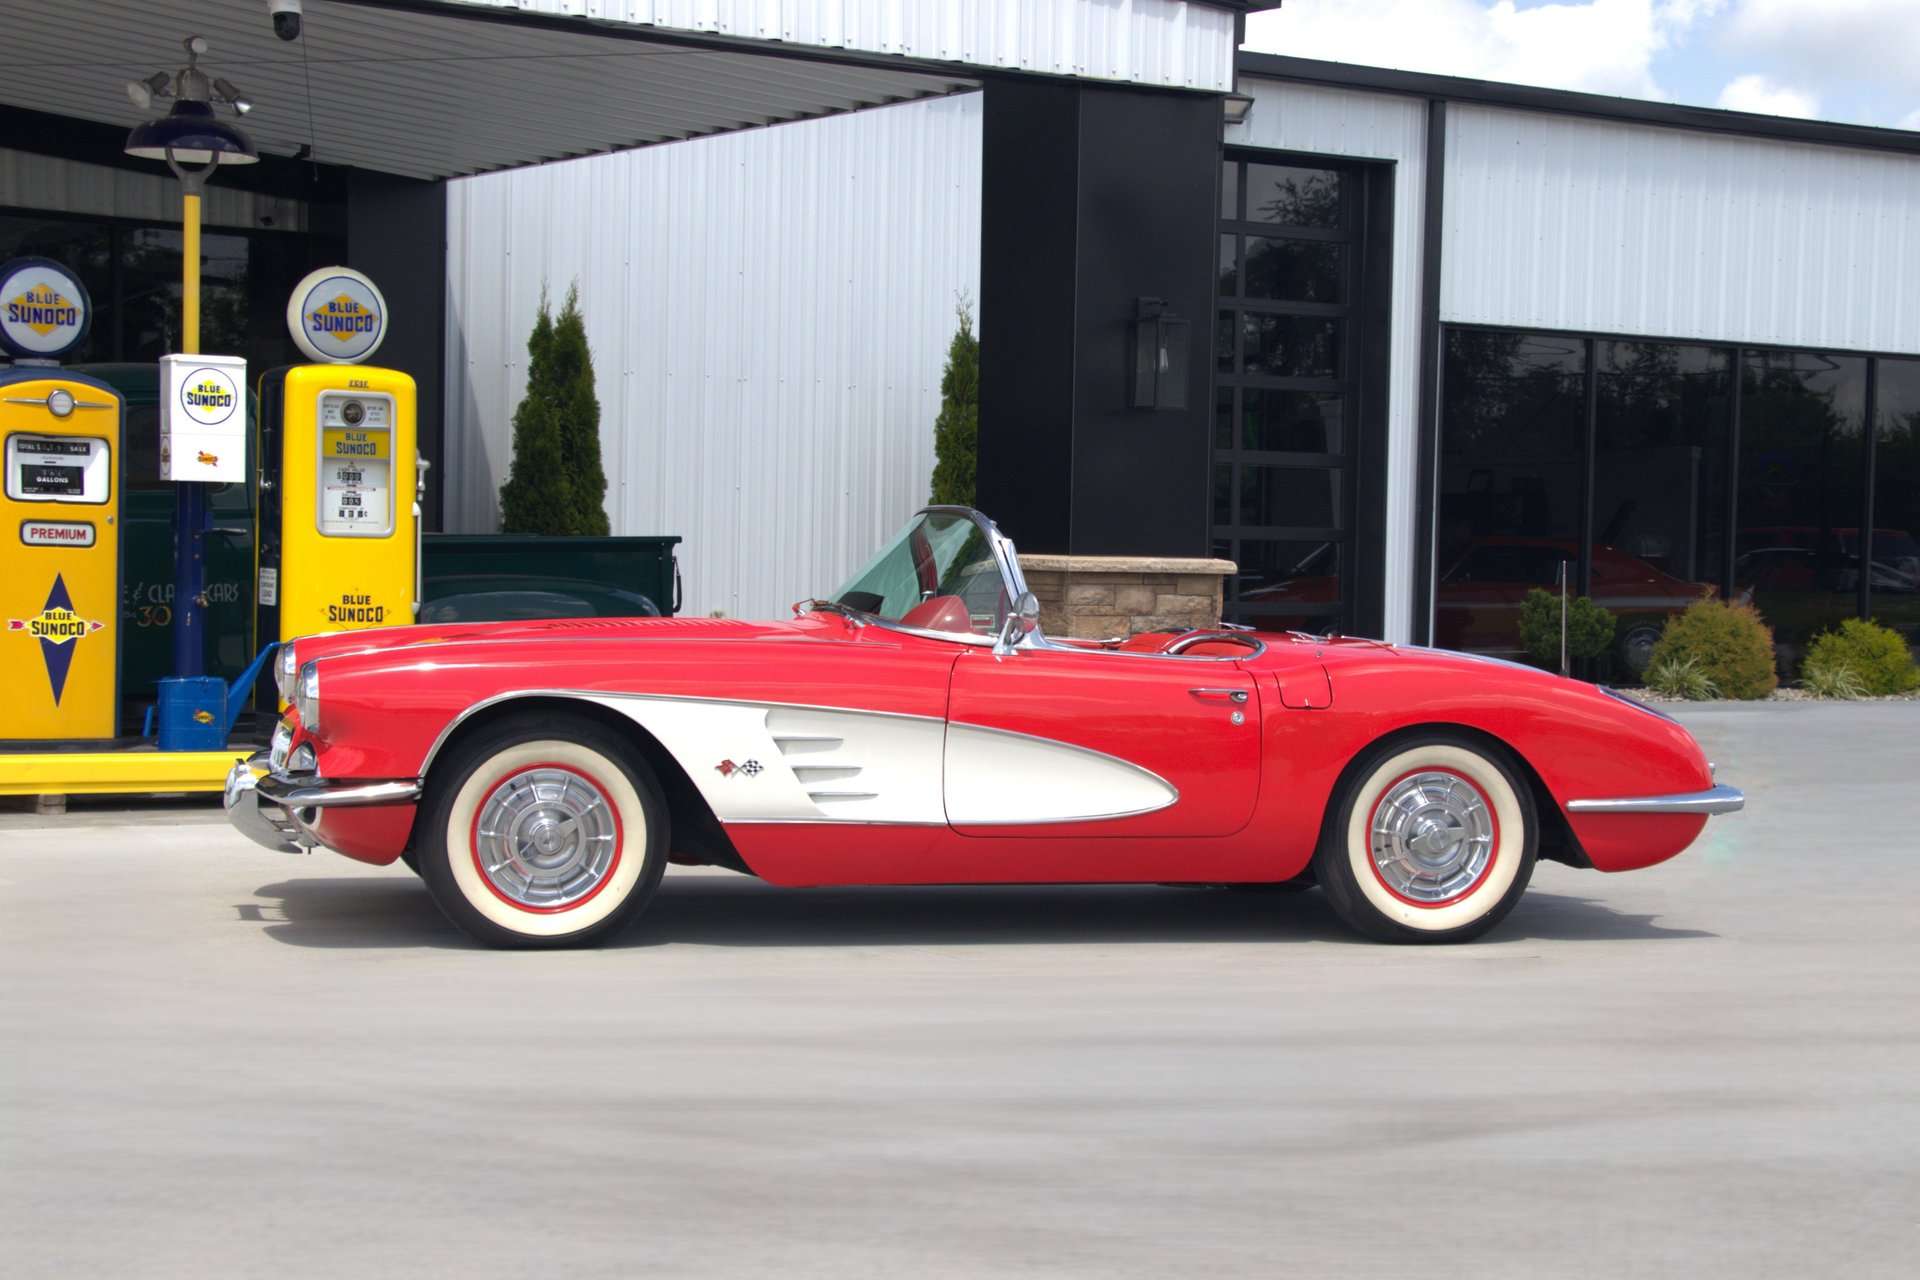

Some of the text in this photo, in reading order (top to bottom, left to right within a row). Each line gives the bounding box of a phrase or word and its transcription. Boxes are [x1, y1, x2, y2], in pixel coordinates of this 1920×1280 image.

[26, 292, 60, 304] BLUE
[328, 302, 359, 313] BLUE
[9, 303, 76, 326] SUNOCO
[312, 312, 373, 332] SUNOCO
[199, 385, 220, 393] BLUE
[187, 392, 231, 406] SUNOCO
[345, 432, 367, 441] BLUE
[336, 441, 376, 455] SUNOCO
[31, 528, 86, 540] PREMIUM
[206, 584, 239, 602] CARS
[342, 595, 371, 605] BLUE
[44, 612, 72, 621] BLUE
[328, 605, 384, 622] SUNOCO
[31, 621, 85, 636] SUNOCO
